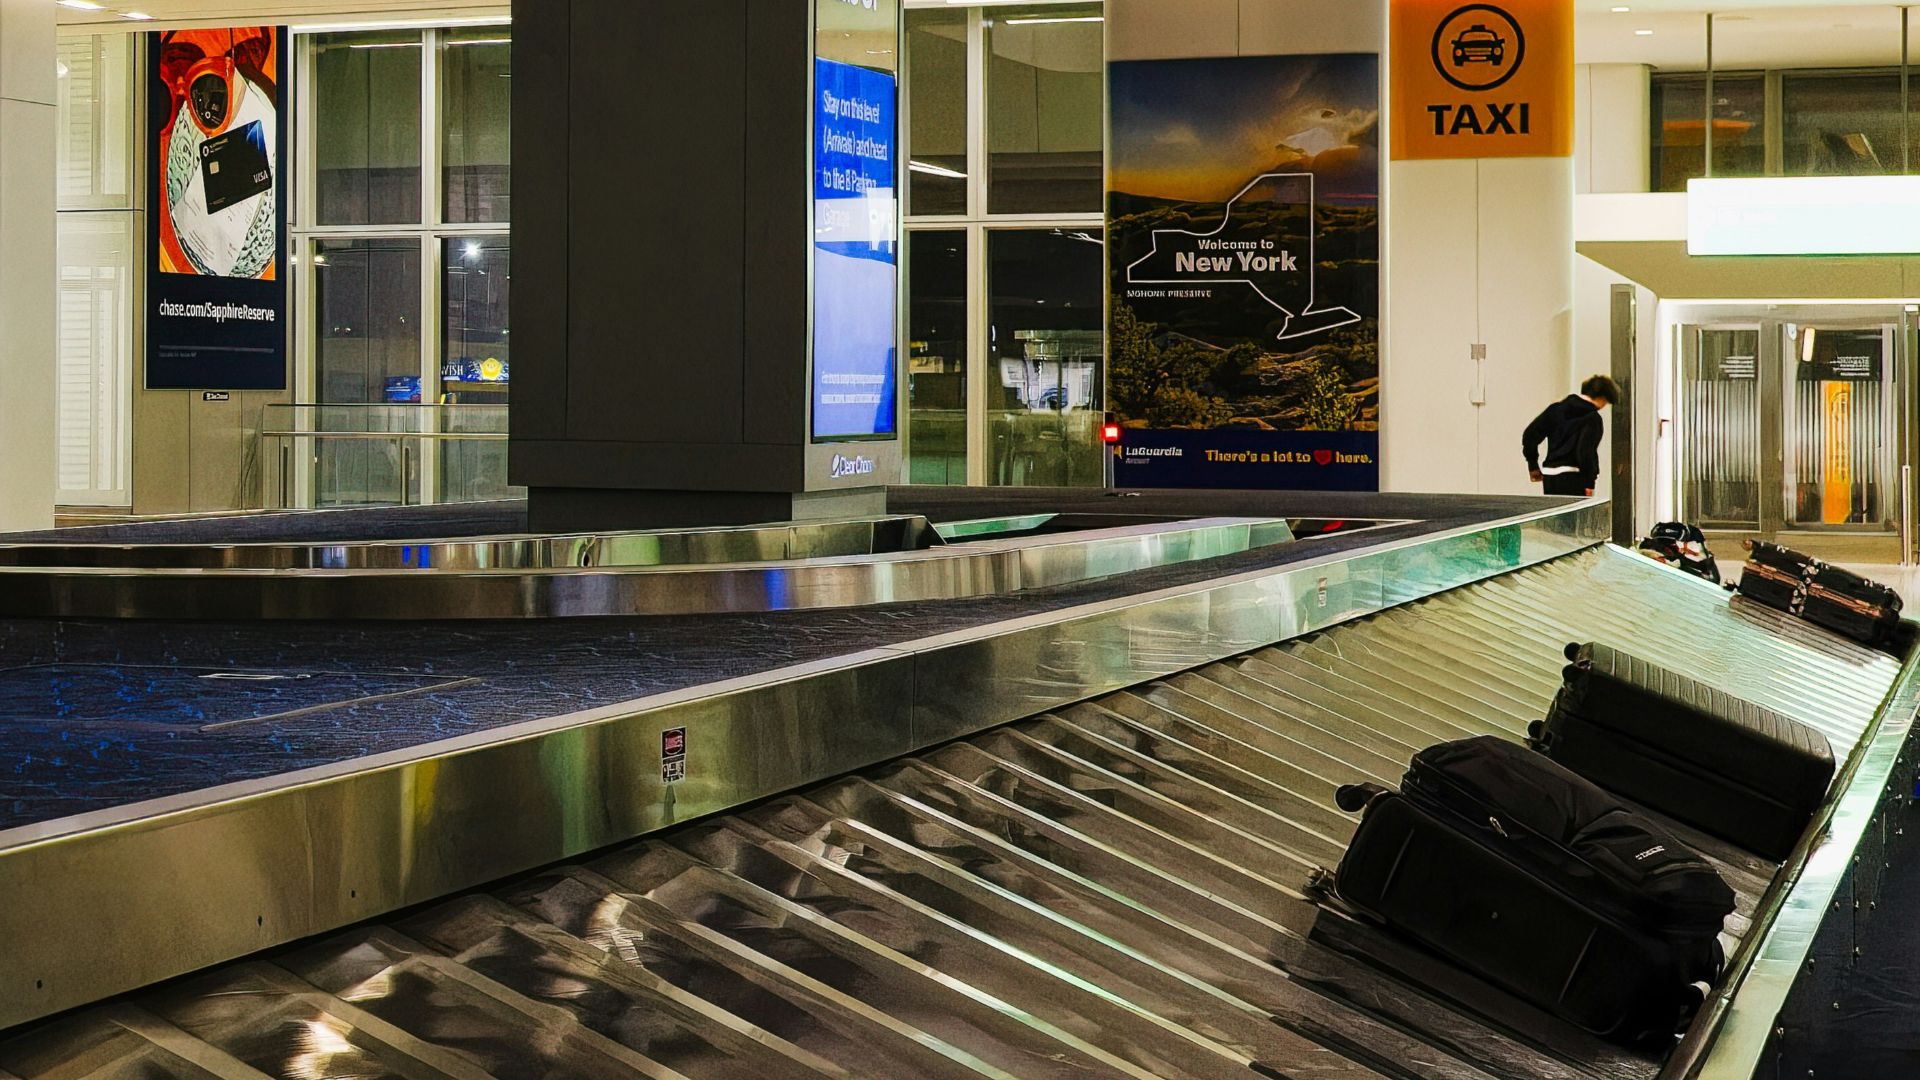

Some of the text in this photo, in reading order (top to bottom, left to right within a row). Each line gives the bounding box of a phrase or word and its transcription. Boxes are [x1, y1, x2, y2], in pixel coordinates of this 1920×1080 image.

[824, 90, 840, 120] Stay
[840, 99, 851, 117] on
[863, 100, 880, 124] level
[1426, 102, 1530, 136] TAXI
[823, 125, 855, 157] (Arrivals)
[253, 170, 269, 184] VISA
[823, 166, 832, 188] to
[833, 167, 845, 190] the
[1198, 238, 1274, 250] Welcome to
[1175, 250, 1297, 272] New York
[159, 298, 275, 323] chase.com/SapphireReserve
[1125, 446, 1183, 457] LaGuardia
[1205, 449, 1258, 462] There's
[1273, 450, 1293, 463] lot
[1295, 452, 1311, 463] to
[1335, 451, 1373, 464] here.
